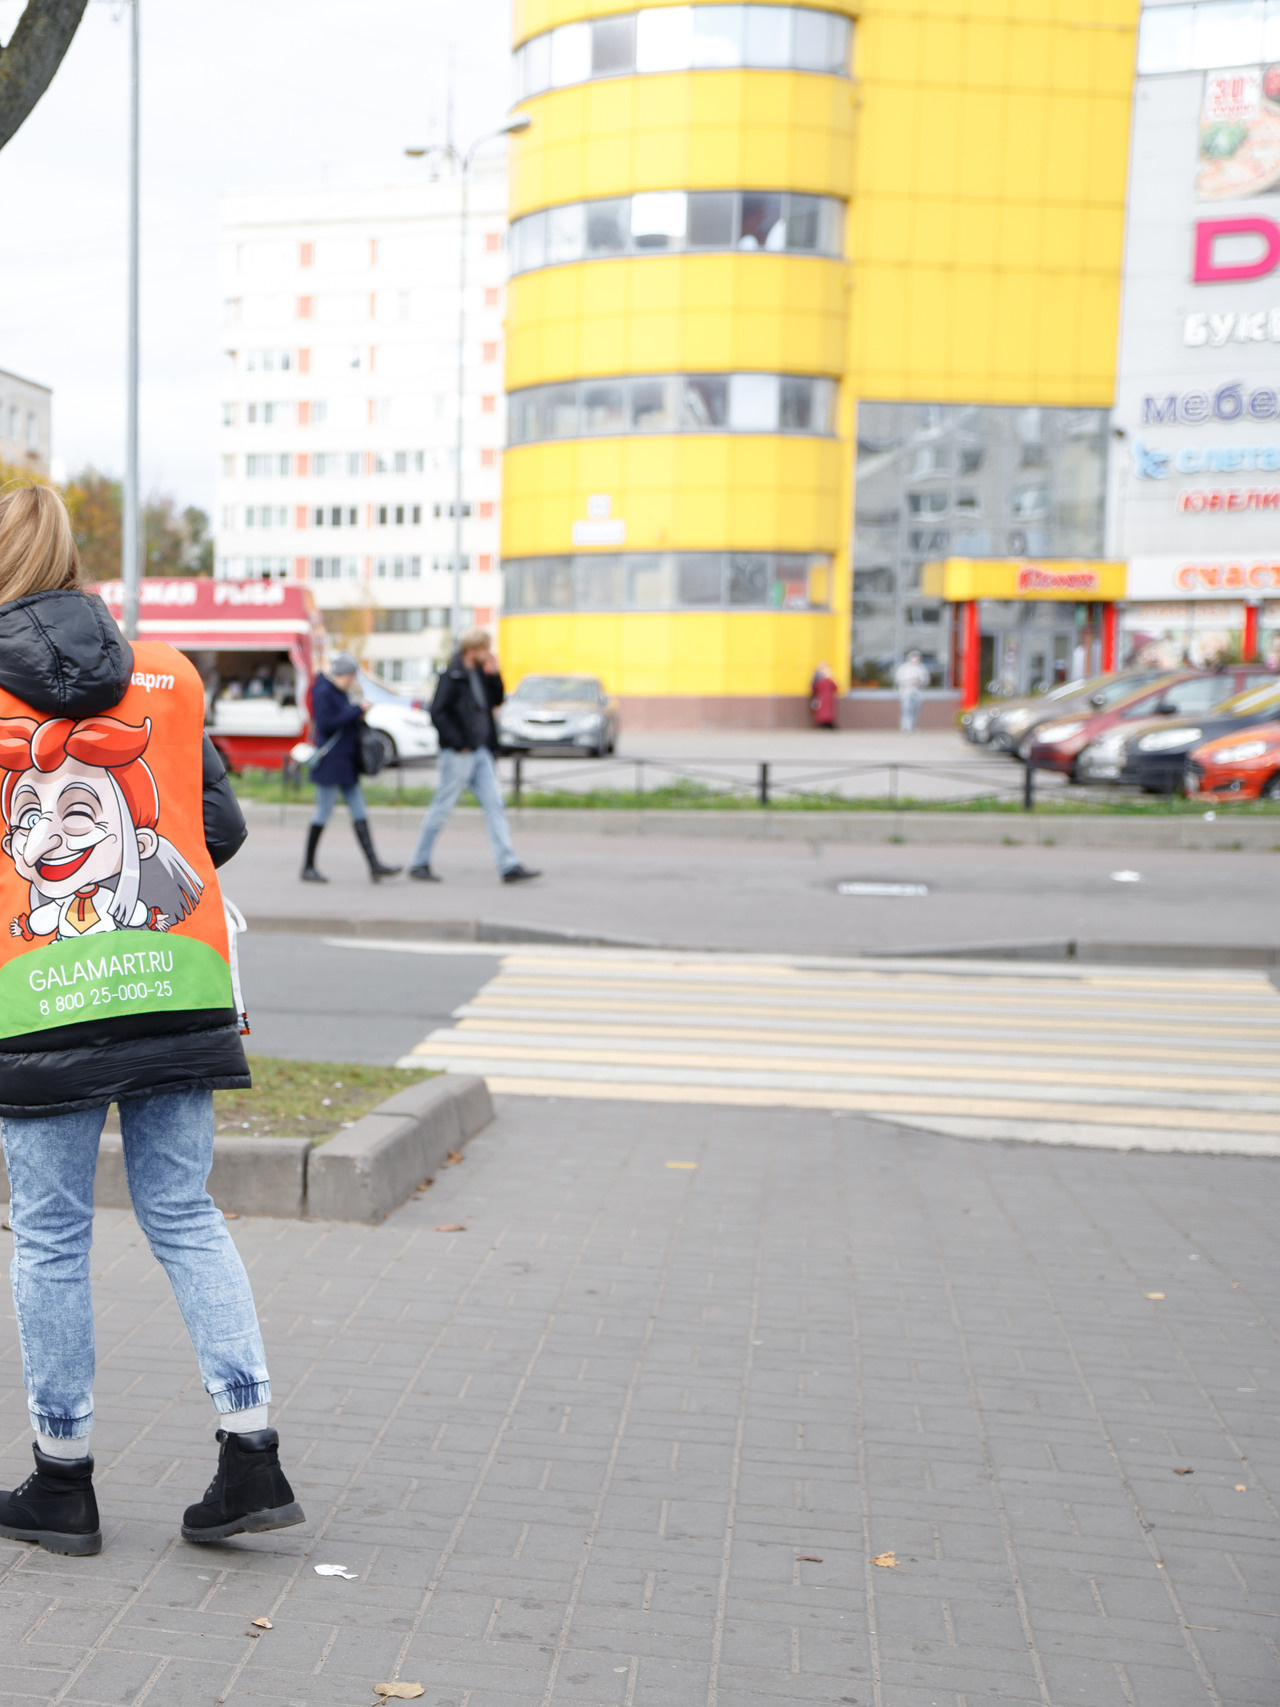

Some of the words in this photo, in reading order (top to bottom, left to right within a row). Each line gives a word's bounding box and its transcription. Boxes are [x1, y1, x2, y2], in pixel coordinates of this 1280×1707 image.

[213, 580, 285, 607] РЫБА
[29, 950, 174, 992] GALAMART.RU
[39, 999, 50, 1016] 8
[55, 992, 85, 1013] 800
[90, 980, 173, 1006] 25-000-25
